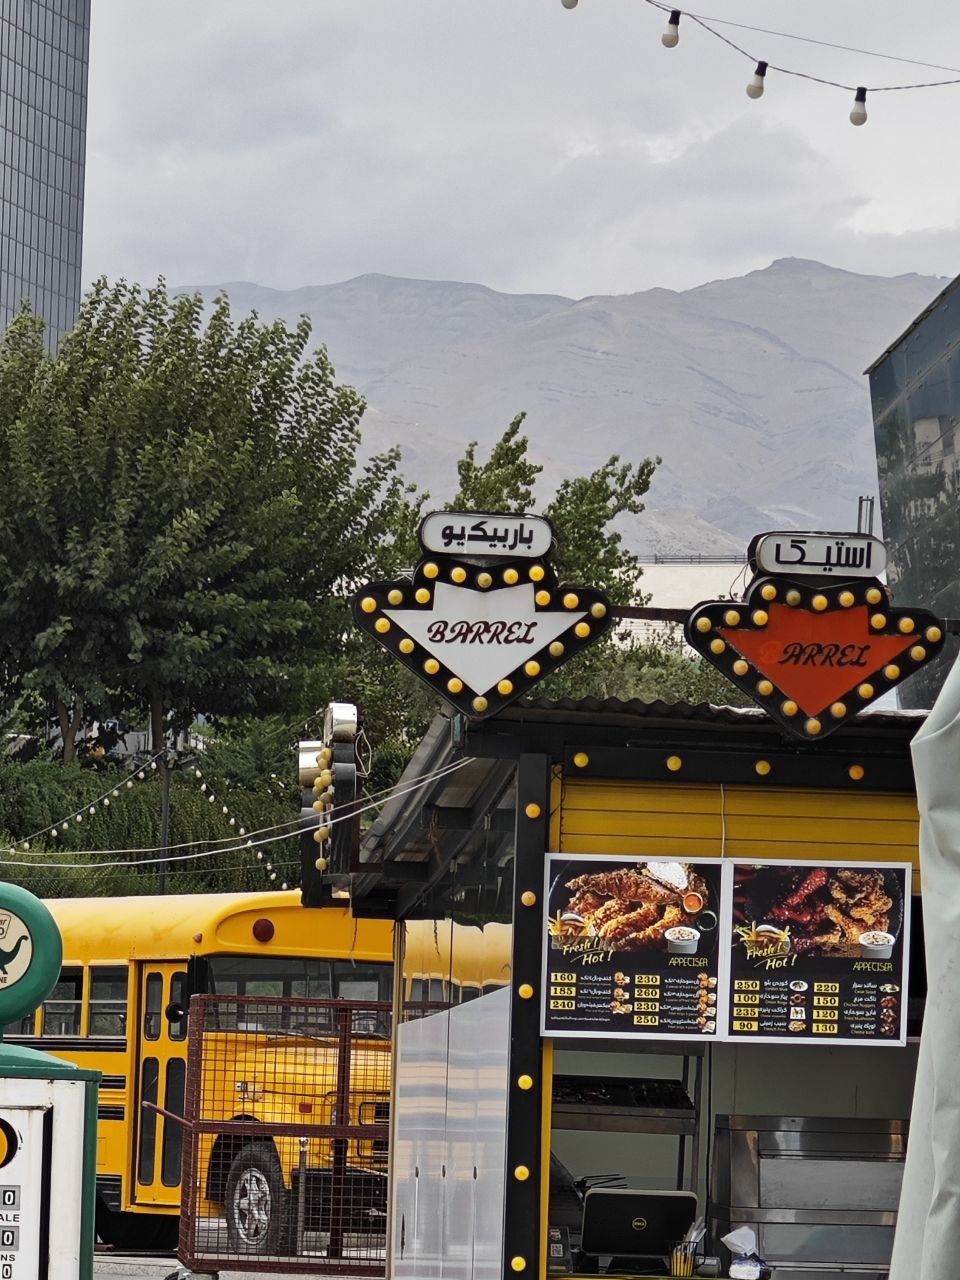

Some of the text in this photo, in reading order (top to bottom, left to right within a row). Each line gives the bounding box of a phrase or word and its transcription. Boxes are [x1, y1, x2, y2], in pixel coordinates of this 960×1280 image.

[774, 539, 873, 573] استیک
[427, 620, 538, 644] BARREL
[554, 973, 573, 981] 160
[637, 976, 658, 984] 230
[736, 981, 758, 989] 250
[816, 984, 837, 992] 220
[554, 987, 573, 995] 185
[636, 989, 657, 997] 260
[737, 994, 757, 1002] 100
[816, 997, 837, 1005] 150
[552, 1001, 573, 1009] 240
[636, 1003, 657, 1011] 230
[736, 1008, 756, 1016] 235
[816, 1010, 836, 1018] 120
[636, 1016, 657, 1024] 250
[739, 1022, 753, 1030] 90
[815, 1024, 836, 1032] 130
